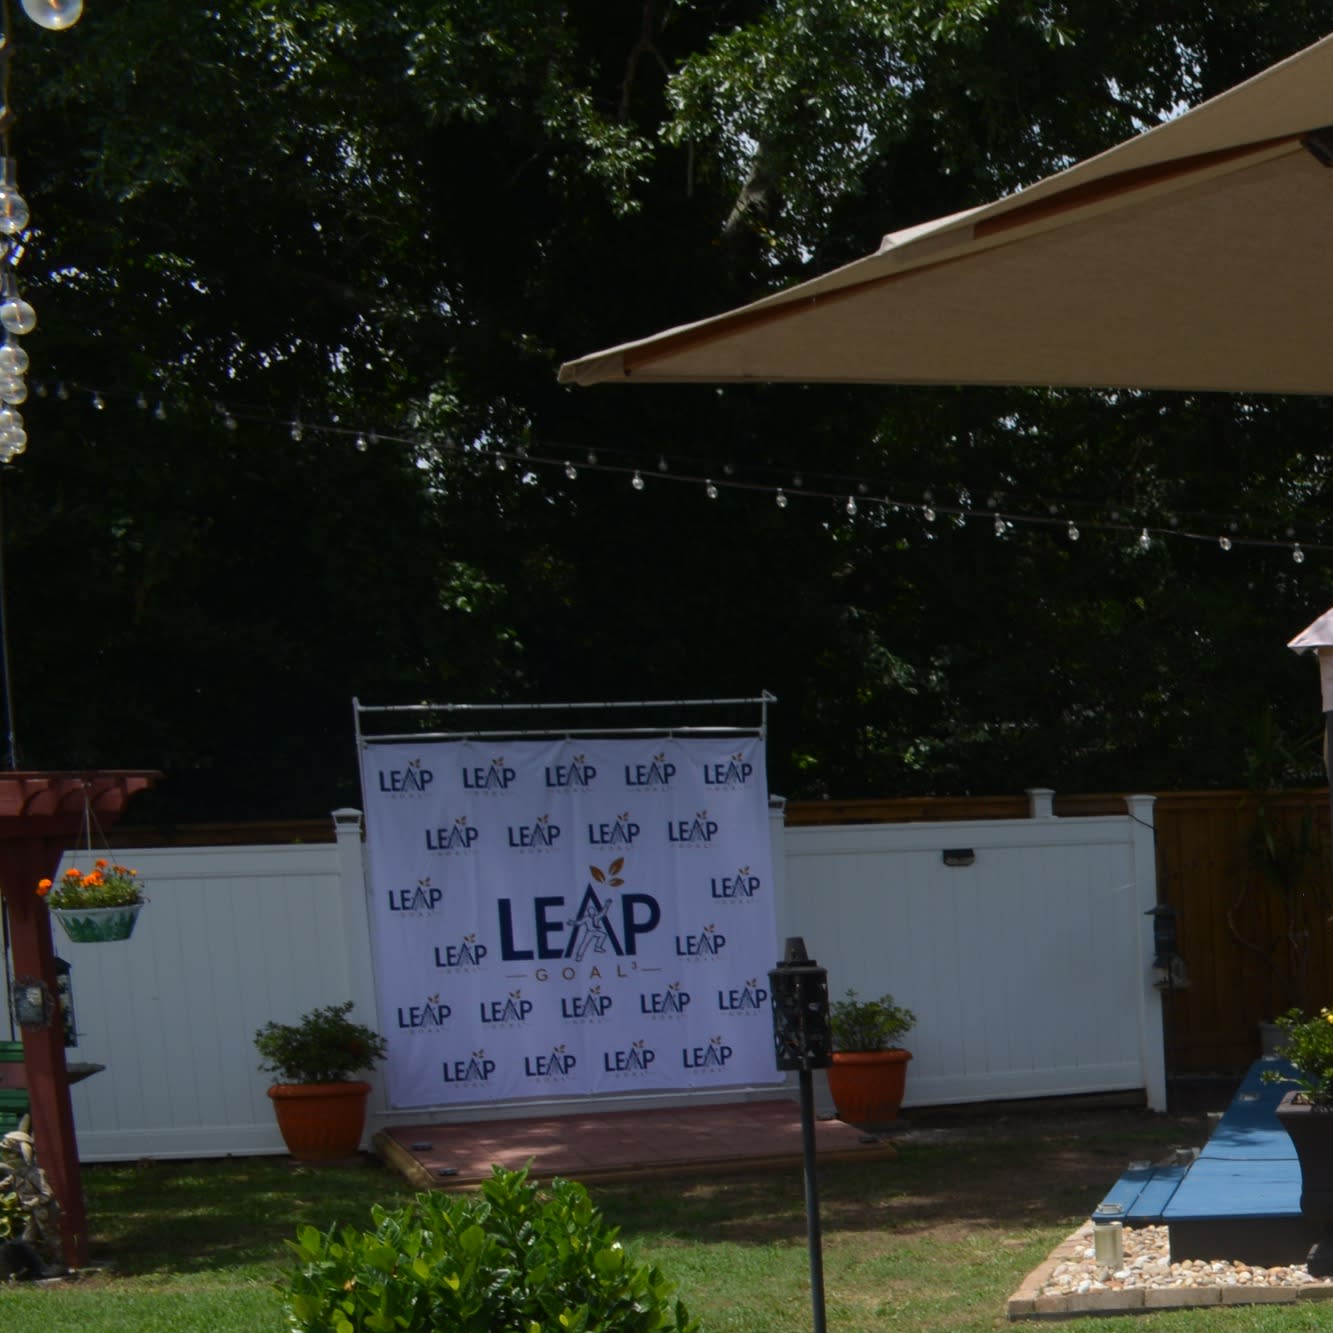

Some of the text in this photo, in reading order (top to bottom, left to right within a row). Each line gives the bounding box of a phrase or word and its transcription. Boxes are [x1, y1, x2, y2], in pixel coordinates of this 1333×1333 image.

[379, 767, 433, 792] LEAP
[462, 765, 516, 789] LEAP
[545, 762, 596, 788] LEAP
[625, 762, 676, 786] LEAP
[704, 761, 753, 784] LEAP
[426, 824, 478, 850] LEAP
[508, 821, 560, 847] LEAP
[589, 820, 640, 844] LEAP
[668, 819, 718, 842] LEAP
[389, 886, 442, 911] LEAP
[711, 875, 760, 898] LEAP
[497, 883, 661, 961] LEAP
[434, 942, 487, 967] LEAP
[676, 933, 726, 956] LEAP
[480, 998, 533, 1023] LEAP
[561, 994, 612, 1018] LEAP
[640, 990, 690, 1014] LEAP
[719, 987, 767, 1010] LEAP
[398, 1003, 451, 1028] LEAP
[525, 1053, 576, 1077] LEAP
[604, 1048, 655, 1072] LEAP
[683, 1044, 732, 1068] LEAP
[443, 1058, 495, 1083] LEAP
